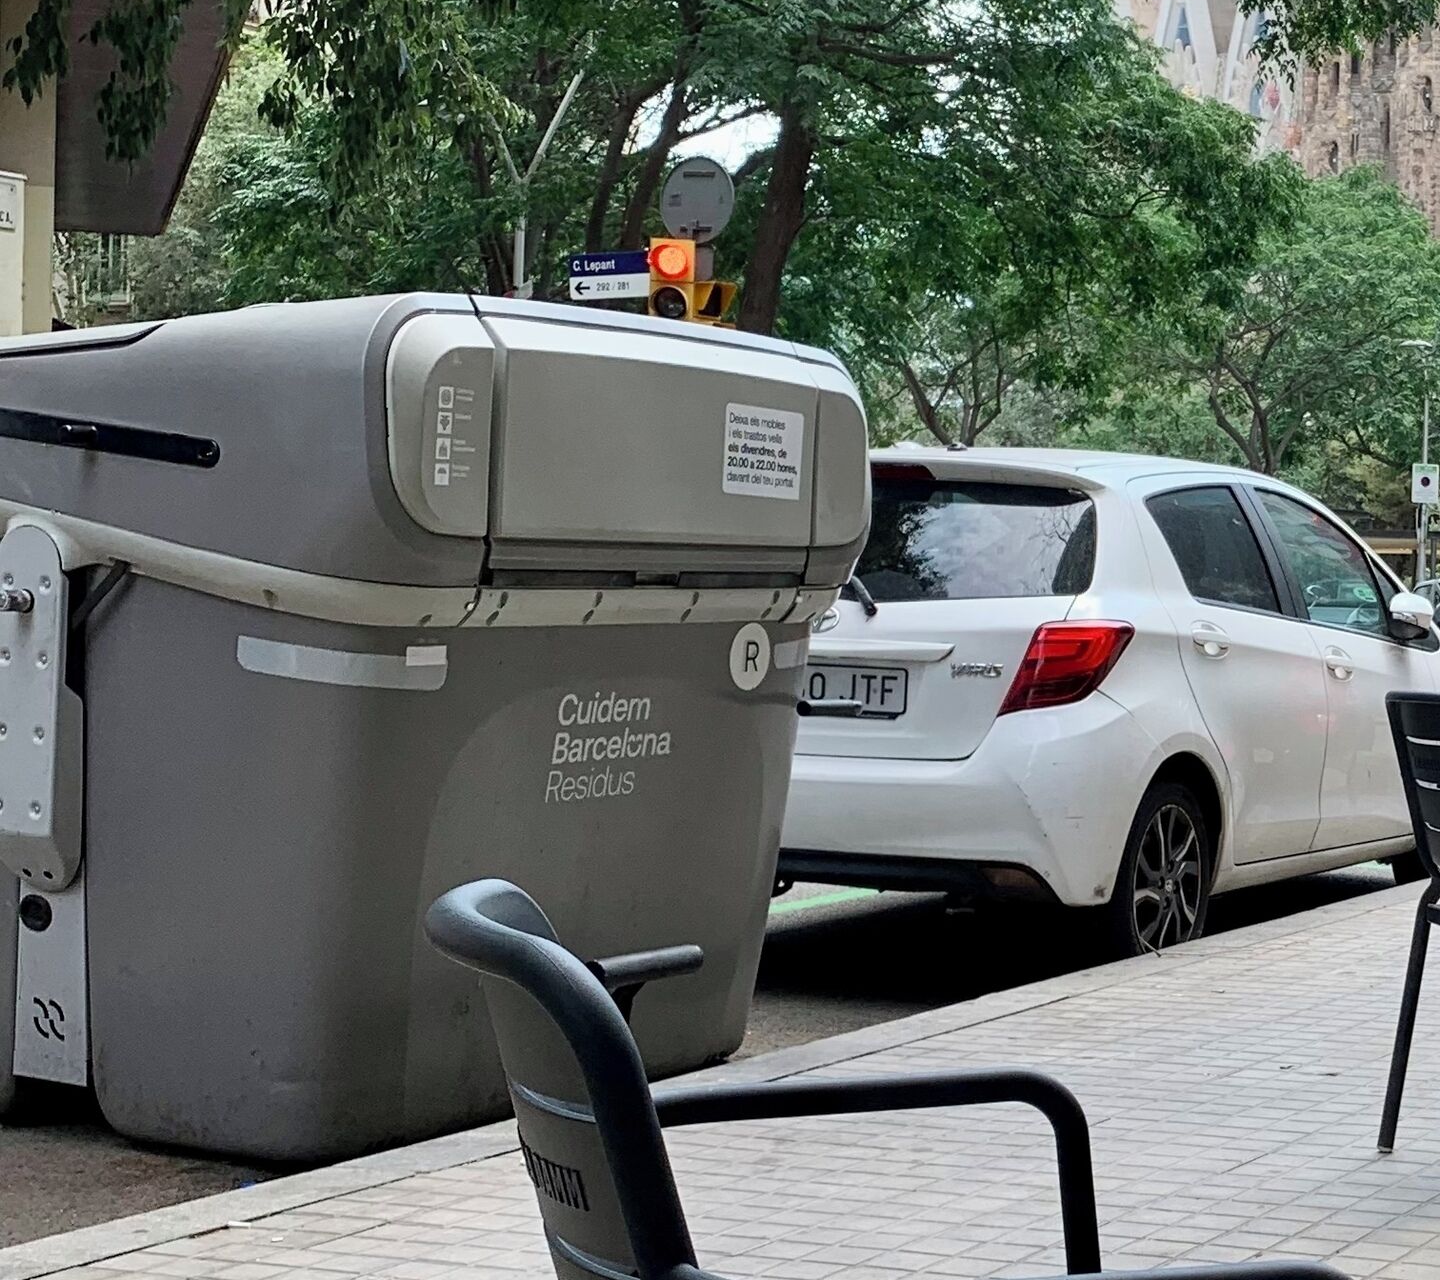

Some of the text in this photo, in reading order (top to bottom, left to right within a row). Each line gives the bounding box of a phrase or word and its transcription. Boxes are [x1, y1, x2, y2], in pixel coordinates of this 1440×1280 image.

[584, 259, 615, 272] Lepant
[729, 412, 748, 426] Deixa
[761, 419, 786, 431] mobles
[744, 430, 767, 442] trastos
[728, 442, 787, 459] els divendres, de
[727, 456, 749, 469] 20.00
[756, 460, 776, 472] 22.00
[727, 470, 750, 482] davant
[745, 641, 759, 673] R
[558, 691, 651, 726] Cuidem
[551, 726, 671, 765] Barcelona
[545, 765, 636, 803] Residus
